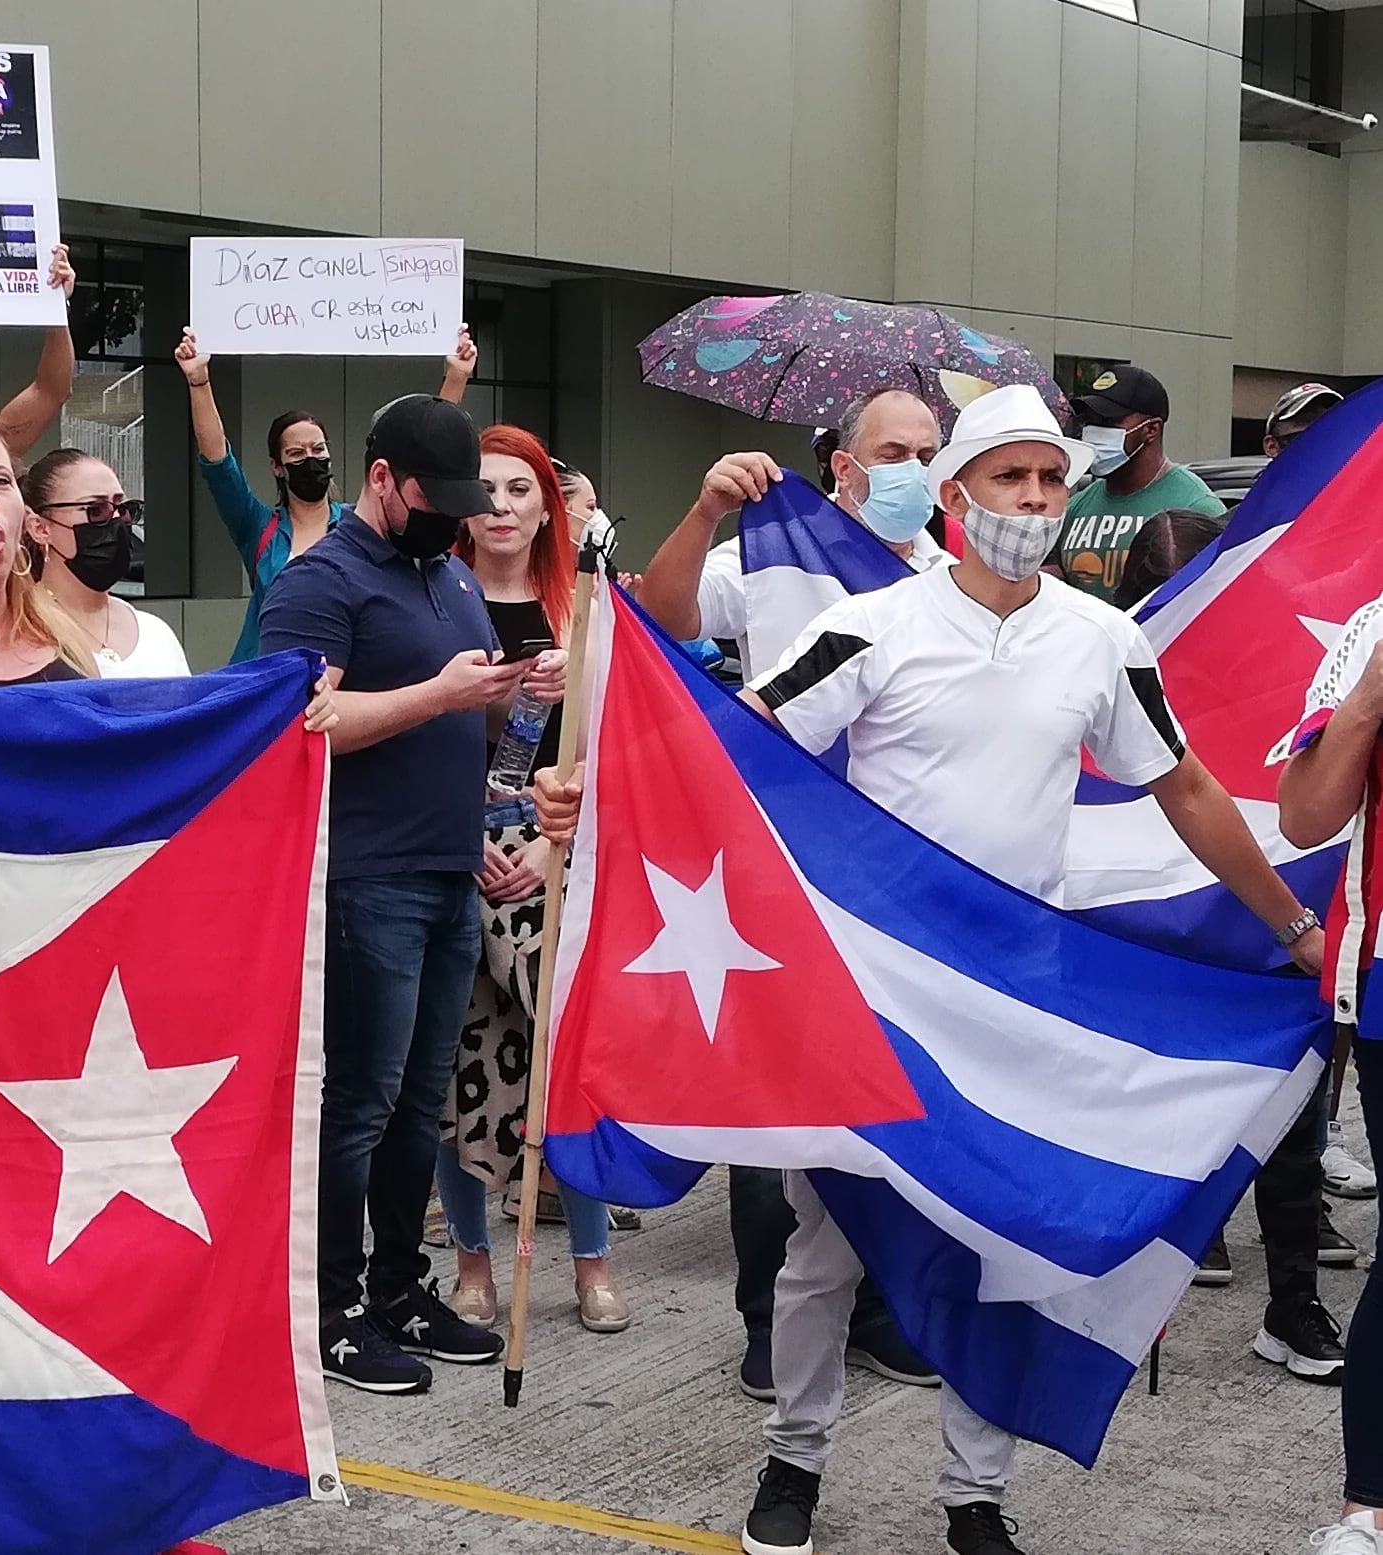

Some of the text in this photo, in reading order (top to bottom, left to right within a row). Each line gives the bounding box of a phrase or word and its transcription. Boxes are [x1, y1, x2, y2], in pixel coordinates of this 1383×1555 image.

[3, 271, 38, 282] VIDA
[7, 282, 40, 294] LIBRE
[311, 298, 342, 320] CR
[347, 295, 383, 316] está
[354, 312, 437, 346] ustedes!
